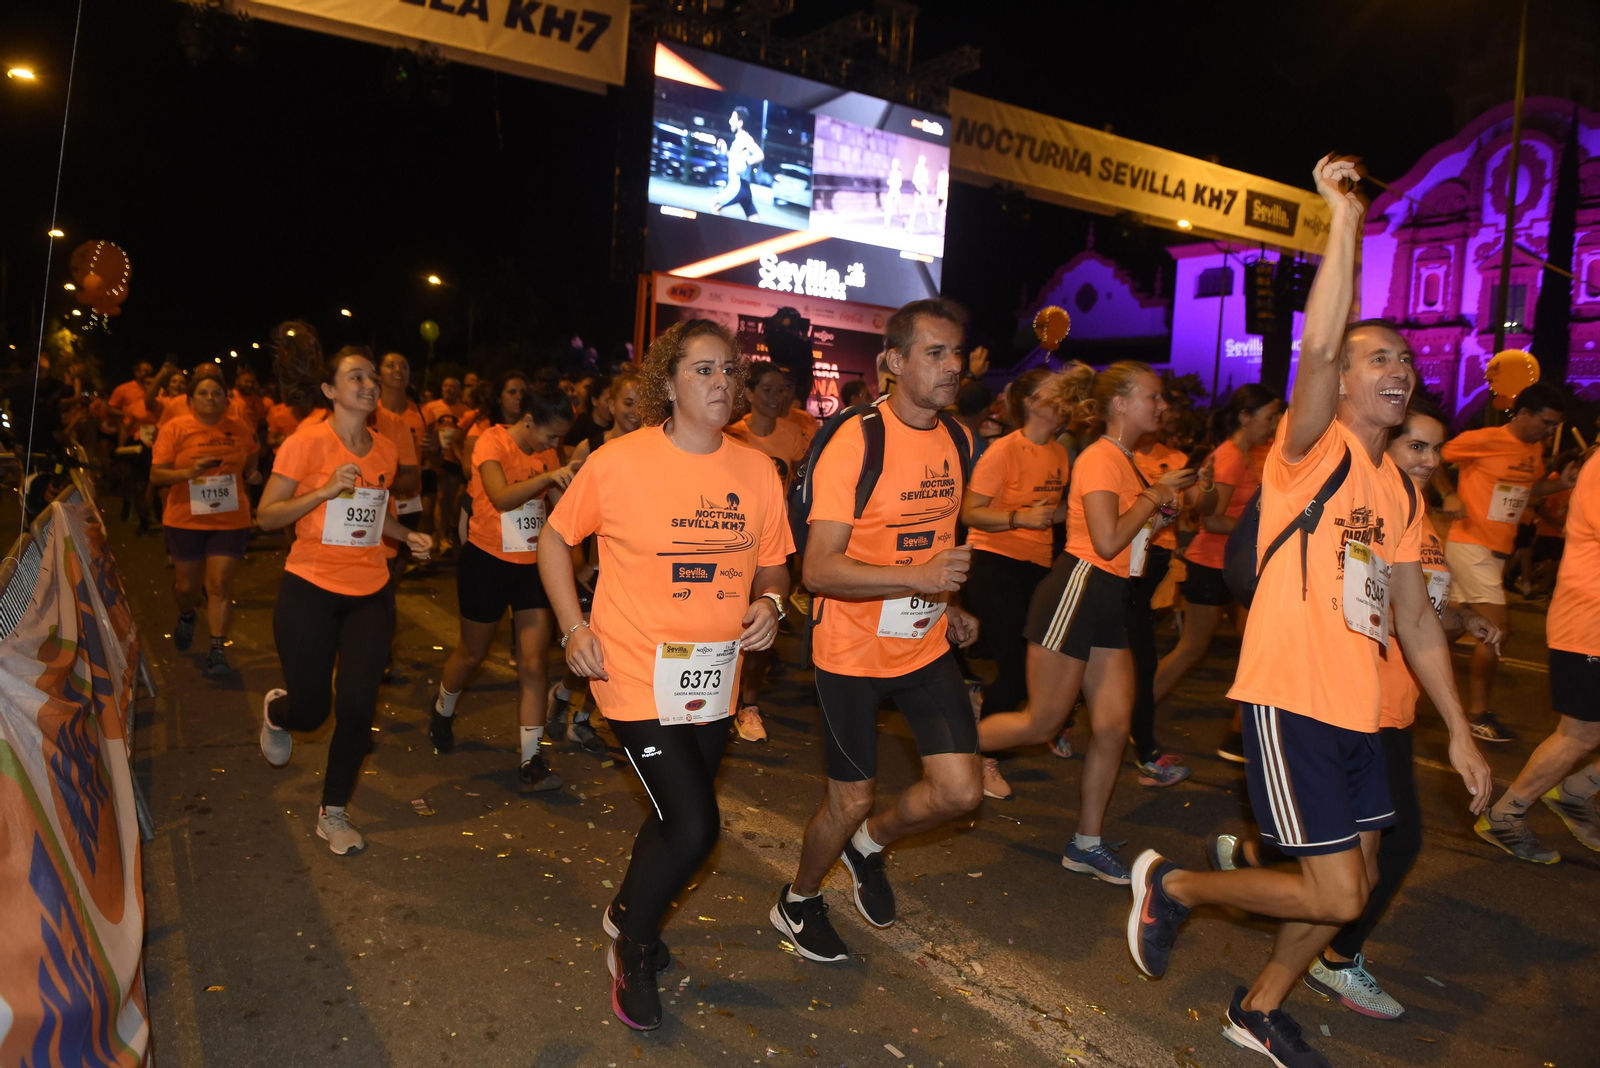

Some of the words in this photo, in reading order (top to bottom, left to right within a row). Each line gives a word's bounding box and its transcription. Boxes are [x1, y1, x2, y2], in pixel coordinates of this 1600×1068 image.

[955, 117, 1092, 177] NOCTURNA
[1098, 157, 1186, 202] SEVILLA
[671, 286, 695, 300] KH7
[920, 479, 955, 488] NOCTURNA
[201, 488, 229, 499] 17158
[900, 489, 938, 501] SEVILLA
[346, 507, 377, 523] 9323
[695, 509, 746, 521] NOCTURNA
[671, 518, 719, 530] SEVILLA
[680, 669, 721, 689] 6373
